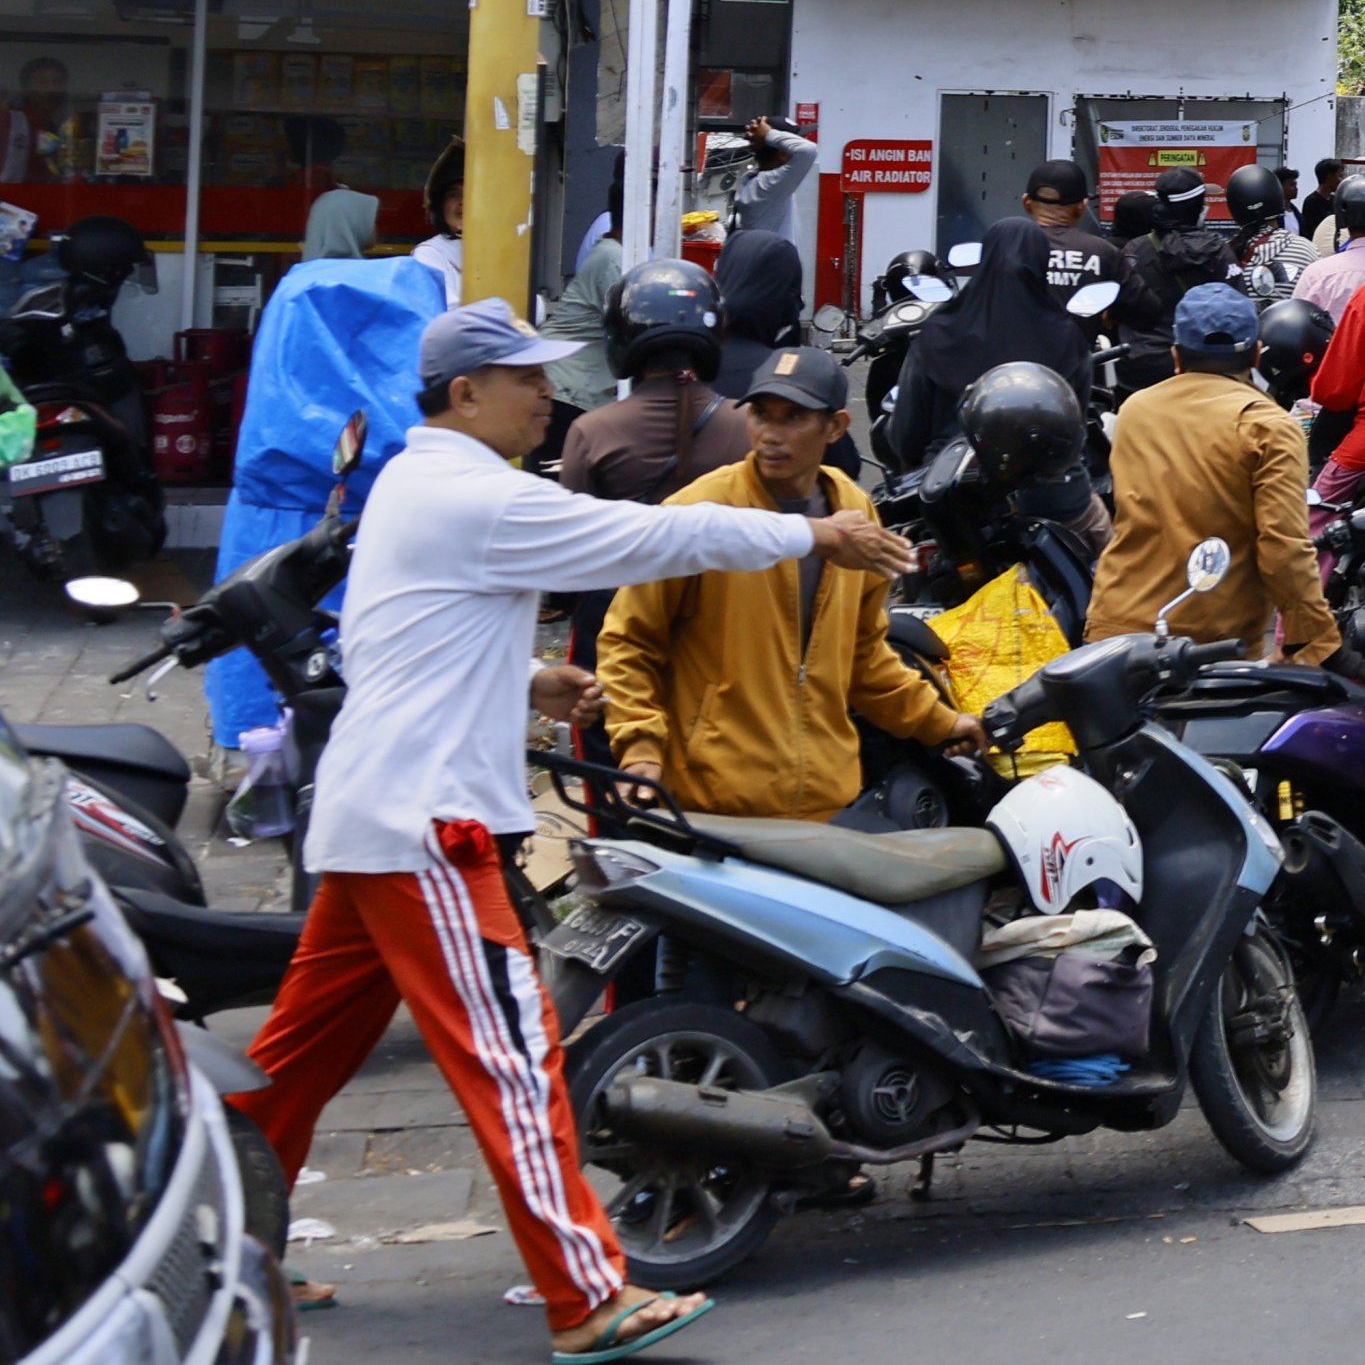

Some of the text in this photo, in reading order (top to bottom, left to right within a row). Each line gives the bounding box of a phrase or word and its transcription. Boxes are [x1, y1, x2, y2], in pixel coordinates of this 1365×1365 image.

[868, 148, 905, 161] ANGIN
[908, 149, 931, 162] BAN
[1160, 152, 1195, 163] PERINGATAN
[874, 170, 931, 184] RADIATOR
[1048, 249, 1100, 276] REA
[1046, 271, 1082, 286] RMY
